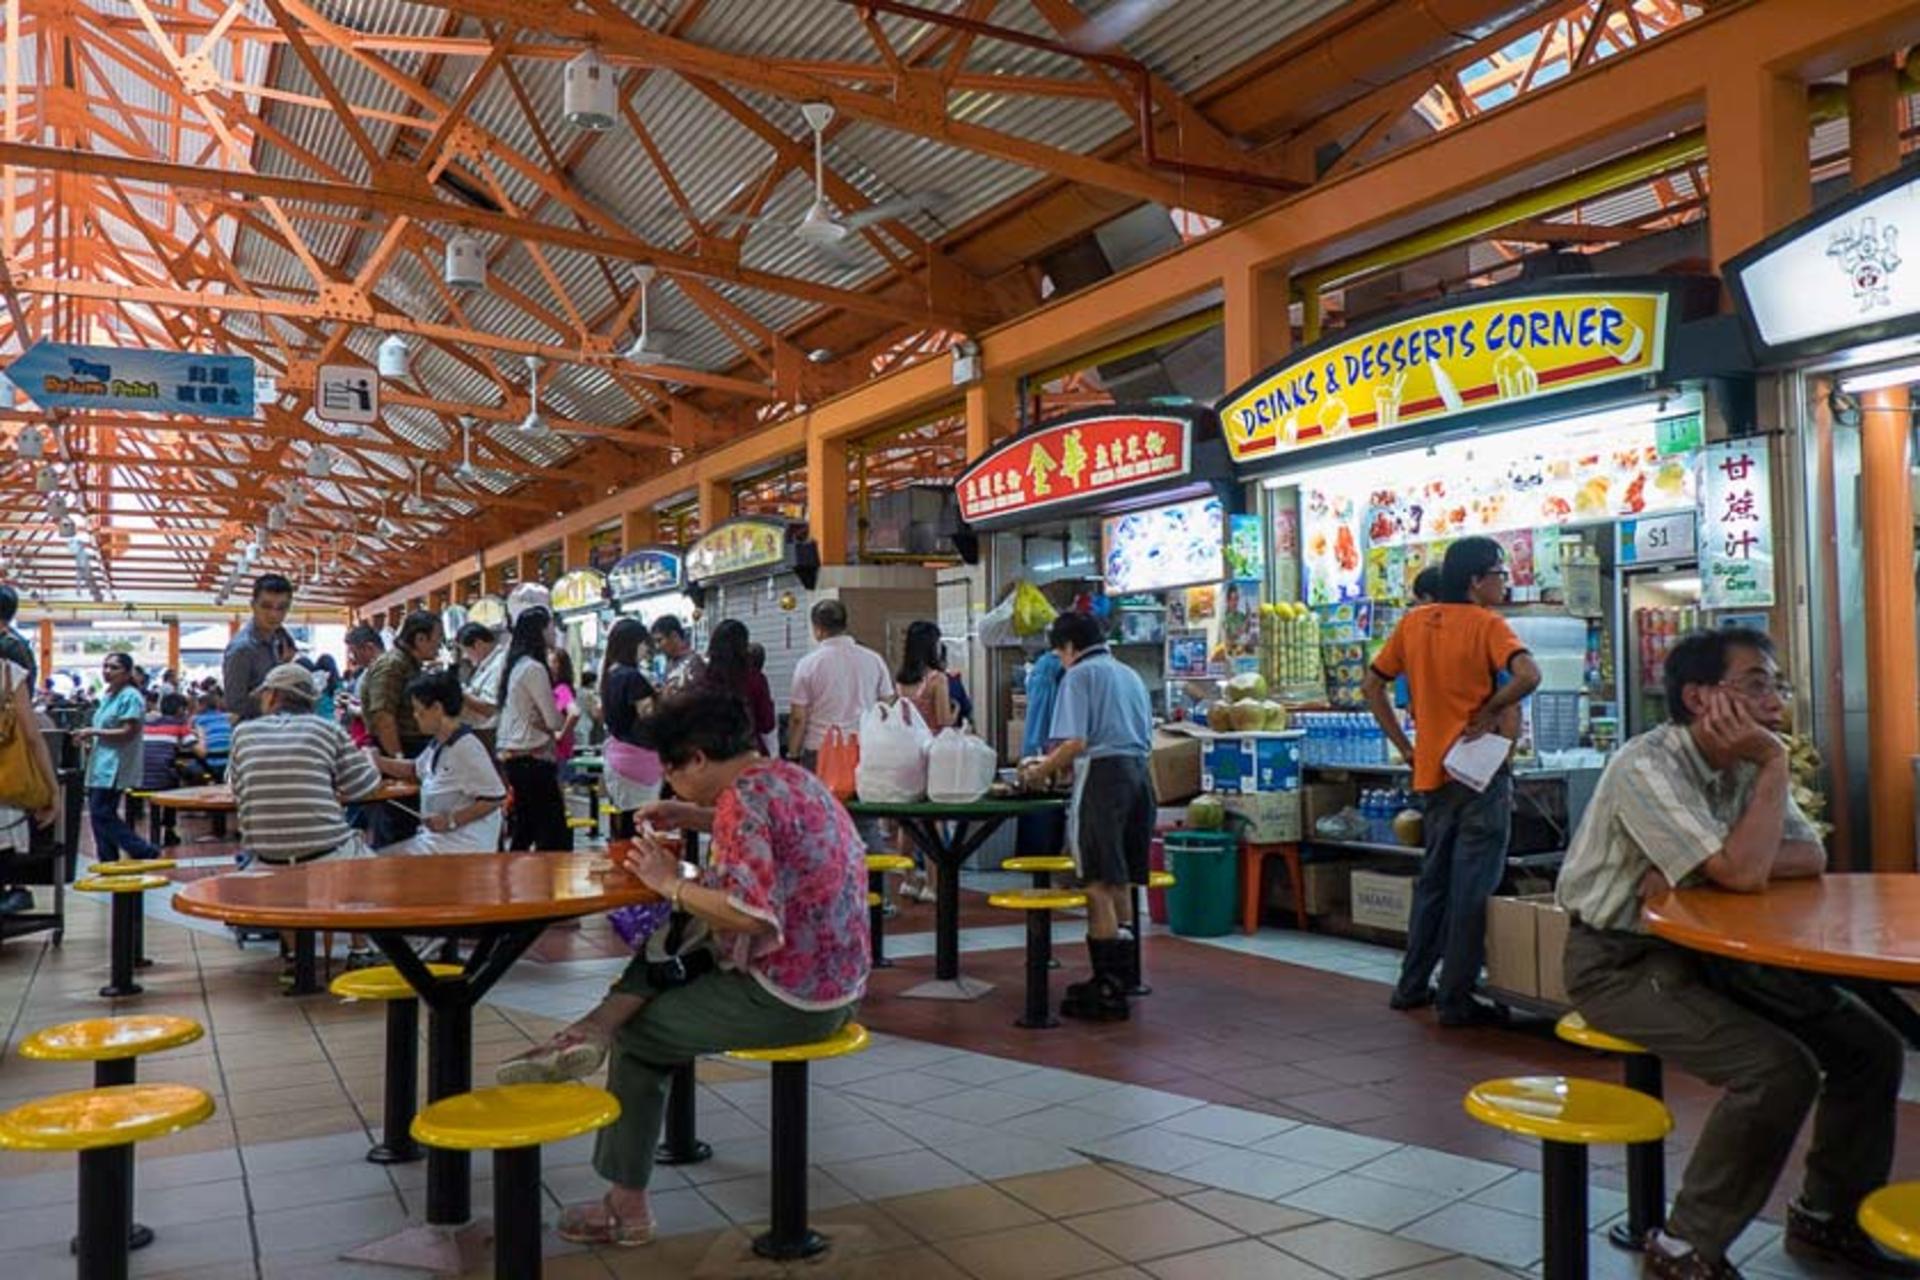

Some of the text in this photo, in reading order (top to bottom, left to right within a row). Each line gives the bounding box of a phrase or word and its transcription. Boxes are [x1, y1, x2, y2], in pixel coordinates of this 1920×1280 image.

[1241, 307, 1624, 436] DRINKS & DESSERTS CORNER
[1648, 527, 1669, 548] S1
[1719, 454, 1759, 559] 甘蔗汁
[1713, 562, 1751, 579] Sugar
